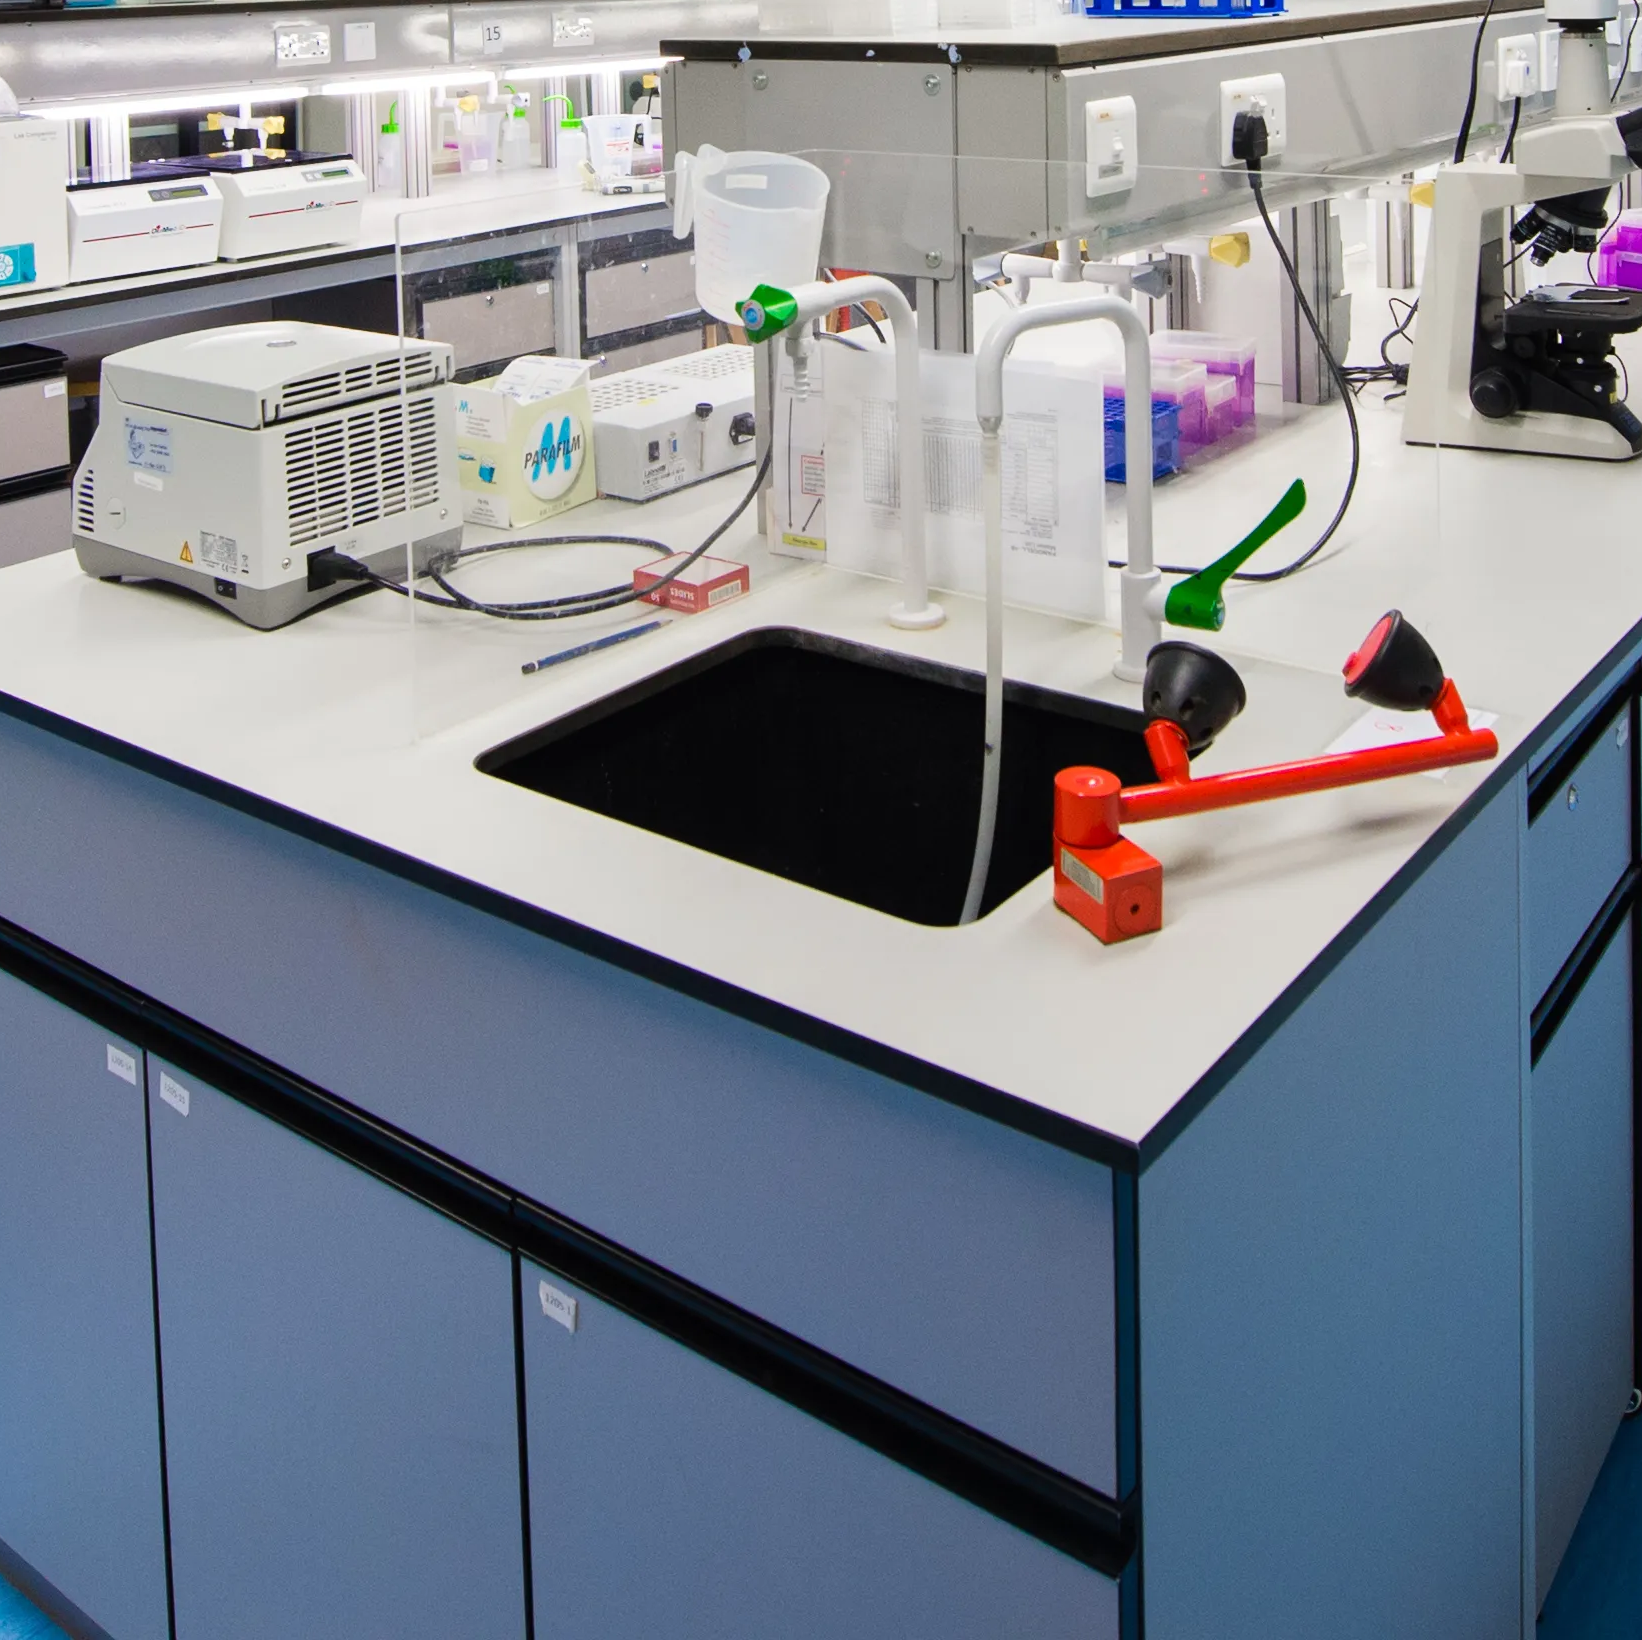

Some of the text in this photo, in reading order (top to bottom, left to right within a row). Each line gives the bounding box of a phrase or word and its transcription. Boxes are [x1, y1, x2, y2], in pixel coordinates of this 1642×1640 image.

[485, 25, 502, 41] 15
[523, 433, 581, 469] PARAFILM
[650, 591, 661, 603] 50
[669, 586, 694, 601] SLIDES
